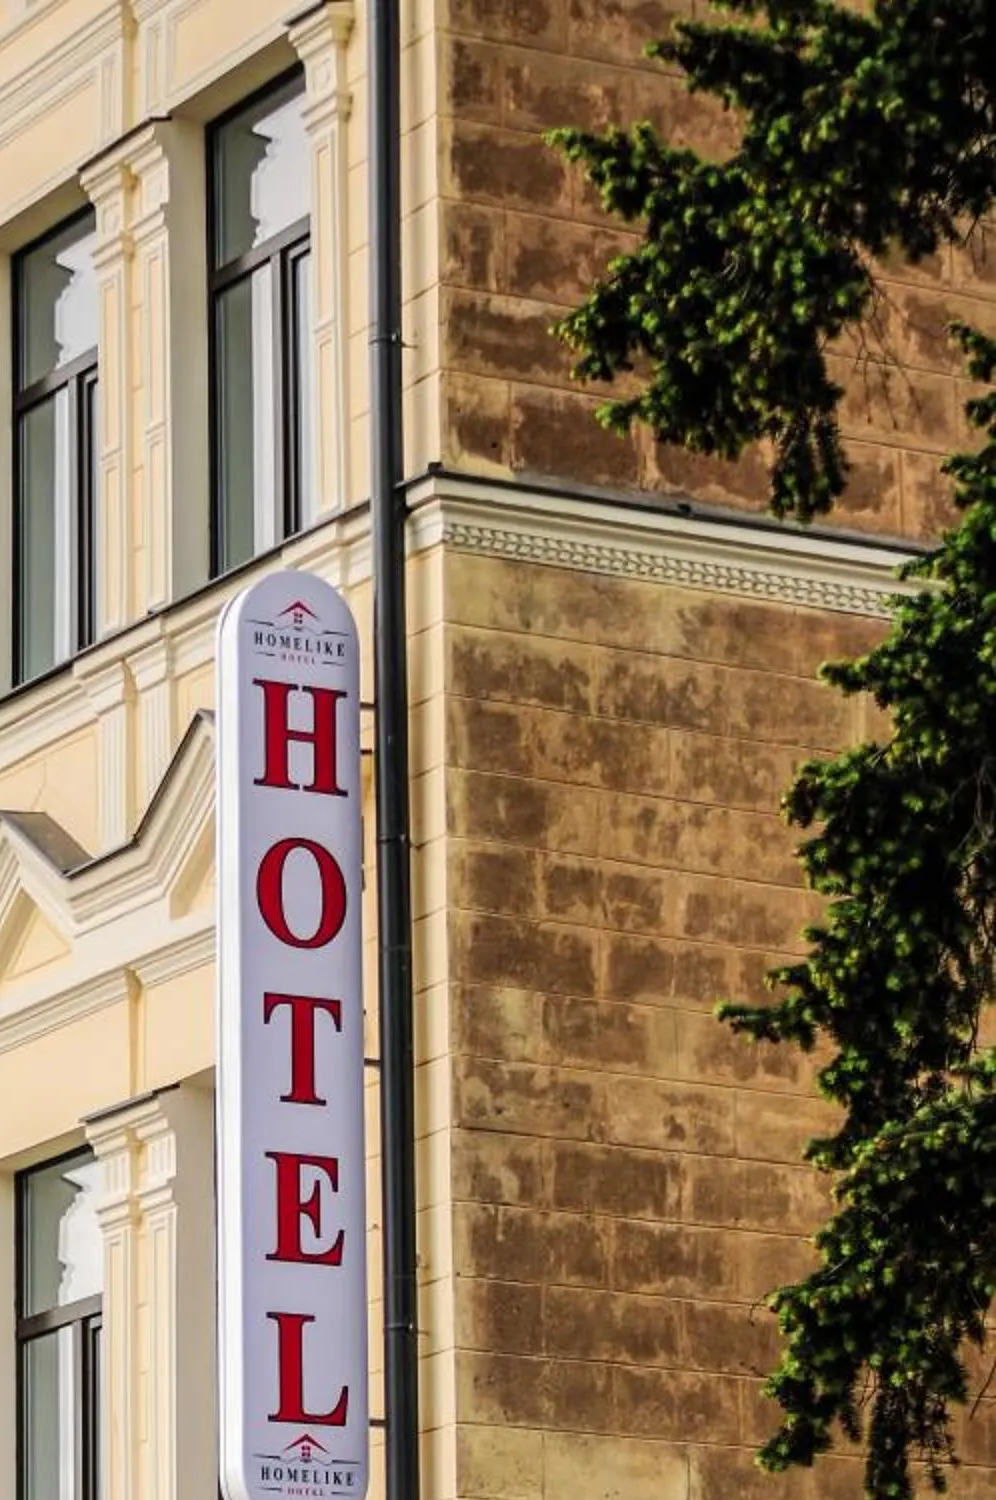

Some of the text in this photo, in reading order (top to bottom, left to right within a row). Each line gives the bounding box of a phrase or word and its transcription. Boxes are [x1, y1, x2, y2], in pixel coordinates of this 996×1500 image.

[254, 631, 346, 657] HOMELIKE
[251, 677, 350, 1427] HOTEL
[261, 1466, 355, 1487] HOMELIKE
